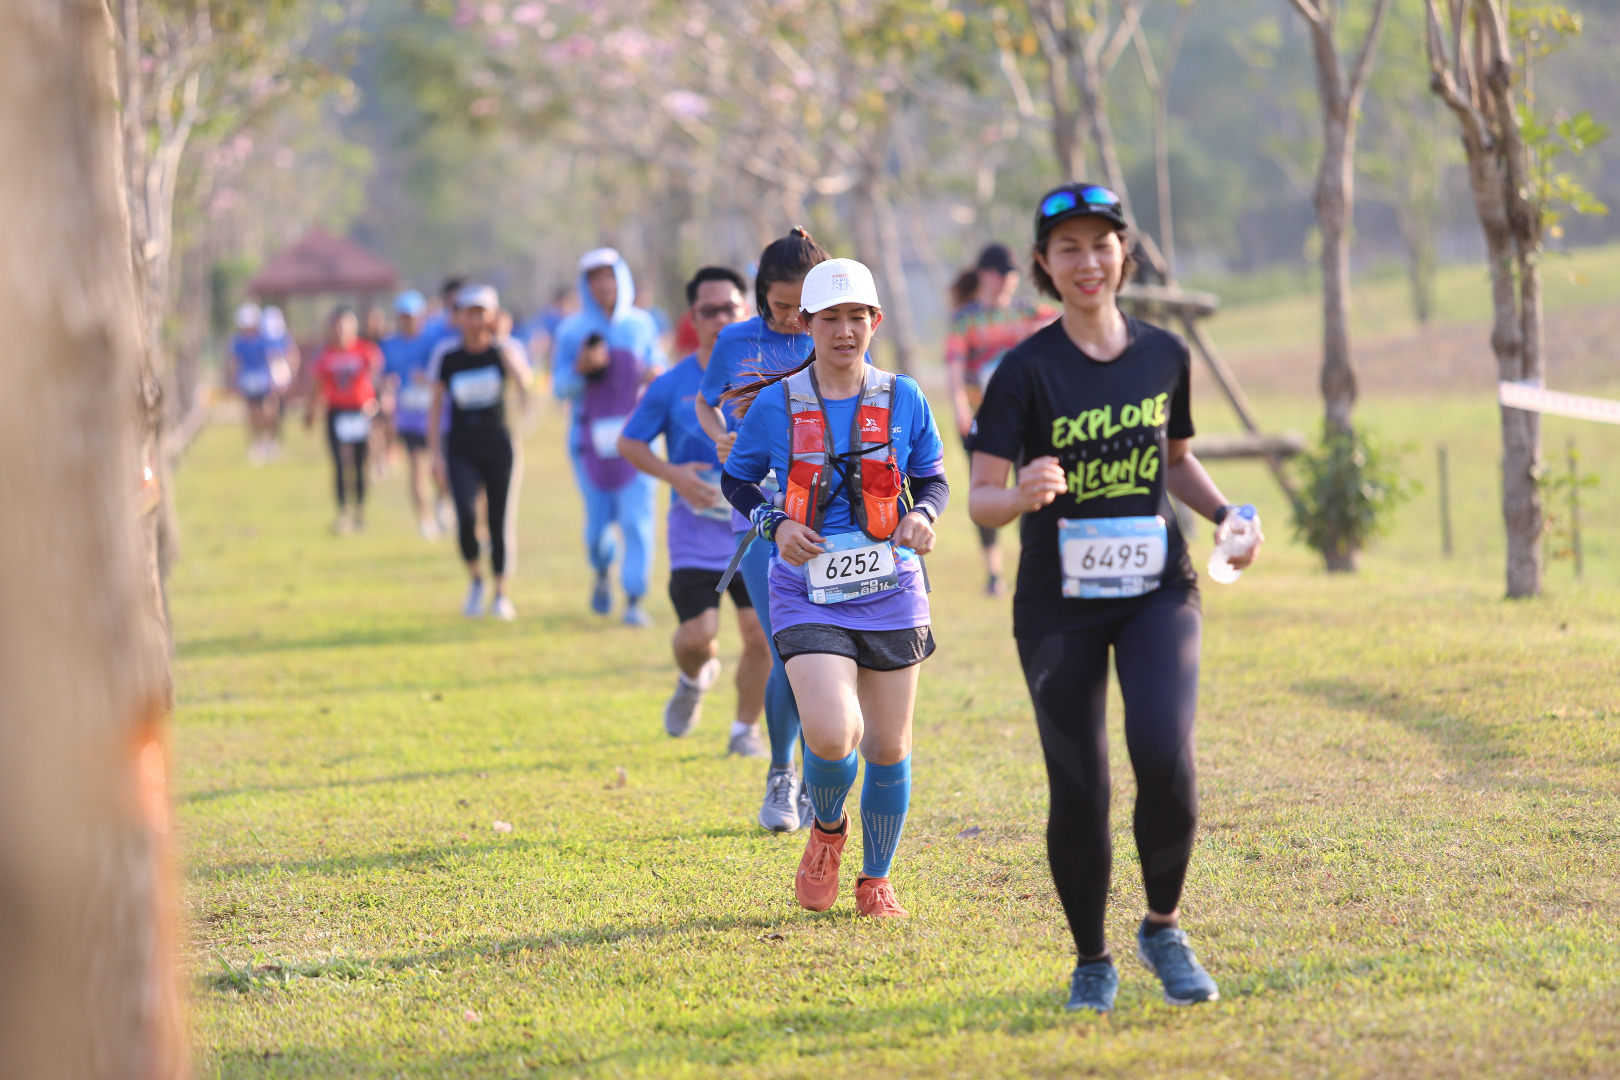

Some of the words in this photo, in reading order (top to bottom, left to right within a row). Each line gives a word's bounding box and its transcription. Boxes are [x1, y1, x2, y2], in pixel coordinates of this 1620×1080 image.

[1052, 392, 1168, 449] EXPLORE
[826, 551, 880, 580] 6252
[1082, 543, 1150, 571] 6495
[879, 581, 889, 591] 16
